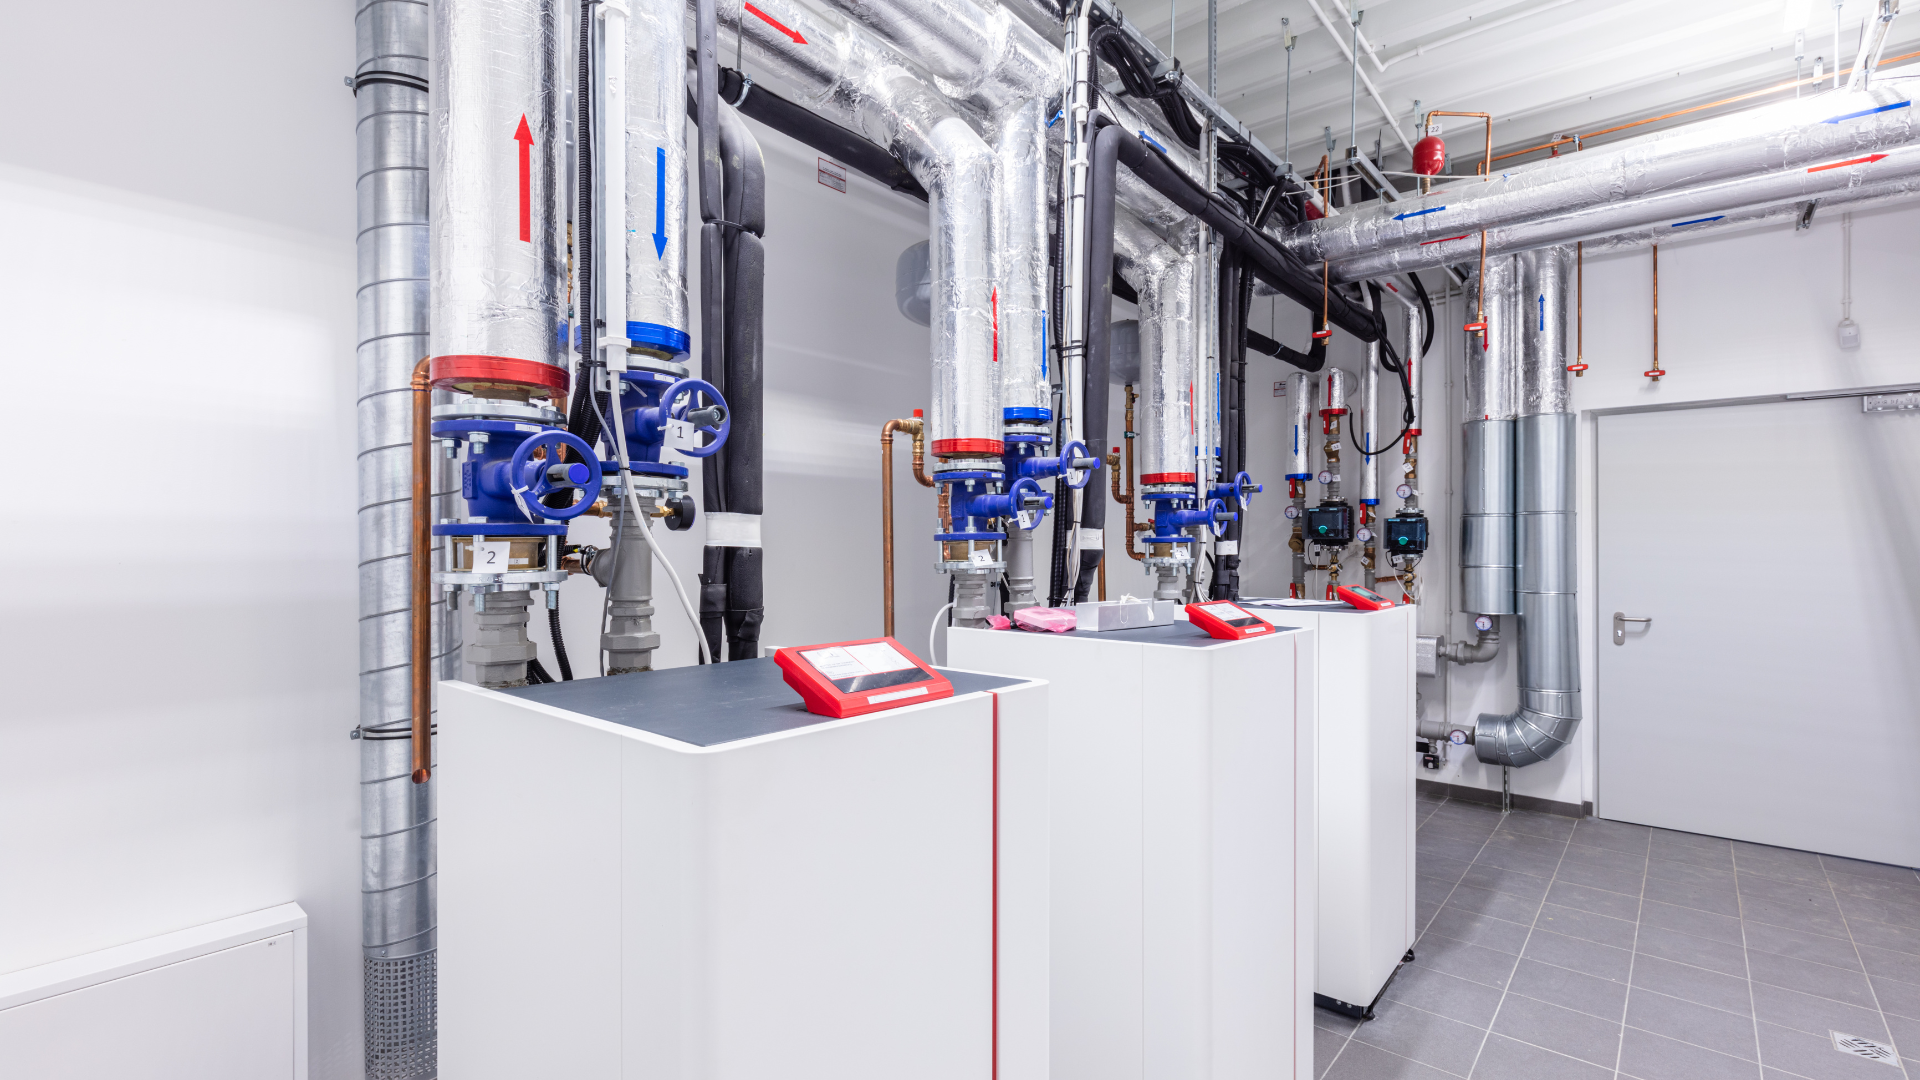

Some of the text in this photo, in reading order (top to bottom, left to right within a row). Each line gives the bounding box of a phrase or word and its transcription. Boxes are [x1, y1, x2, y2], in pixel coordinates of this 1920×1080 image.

[677, 426, 684, 438] 1
[1070, 472, 1074, 480] 1
[1022, 514, 1026, 522] 1
[486, 550, 496, 564] 2
